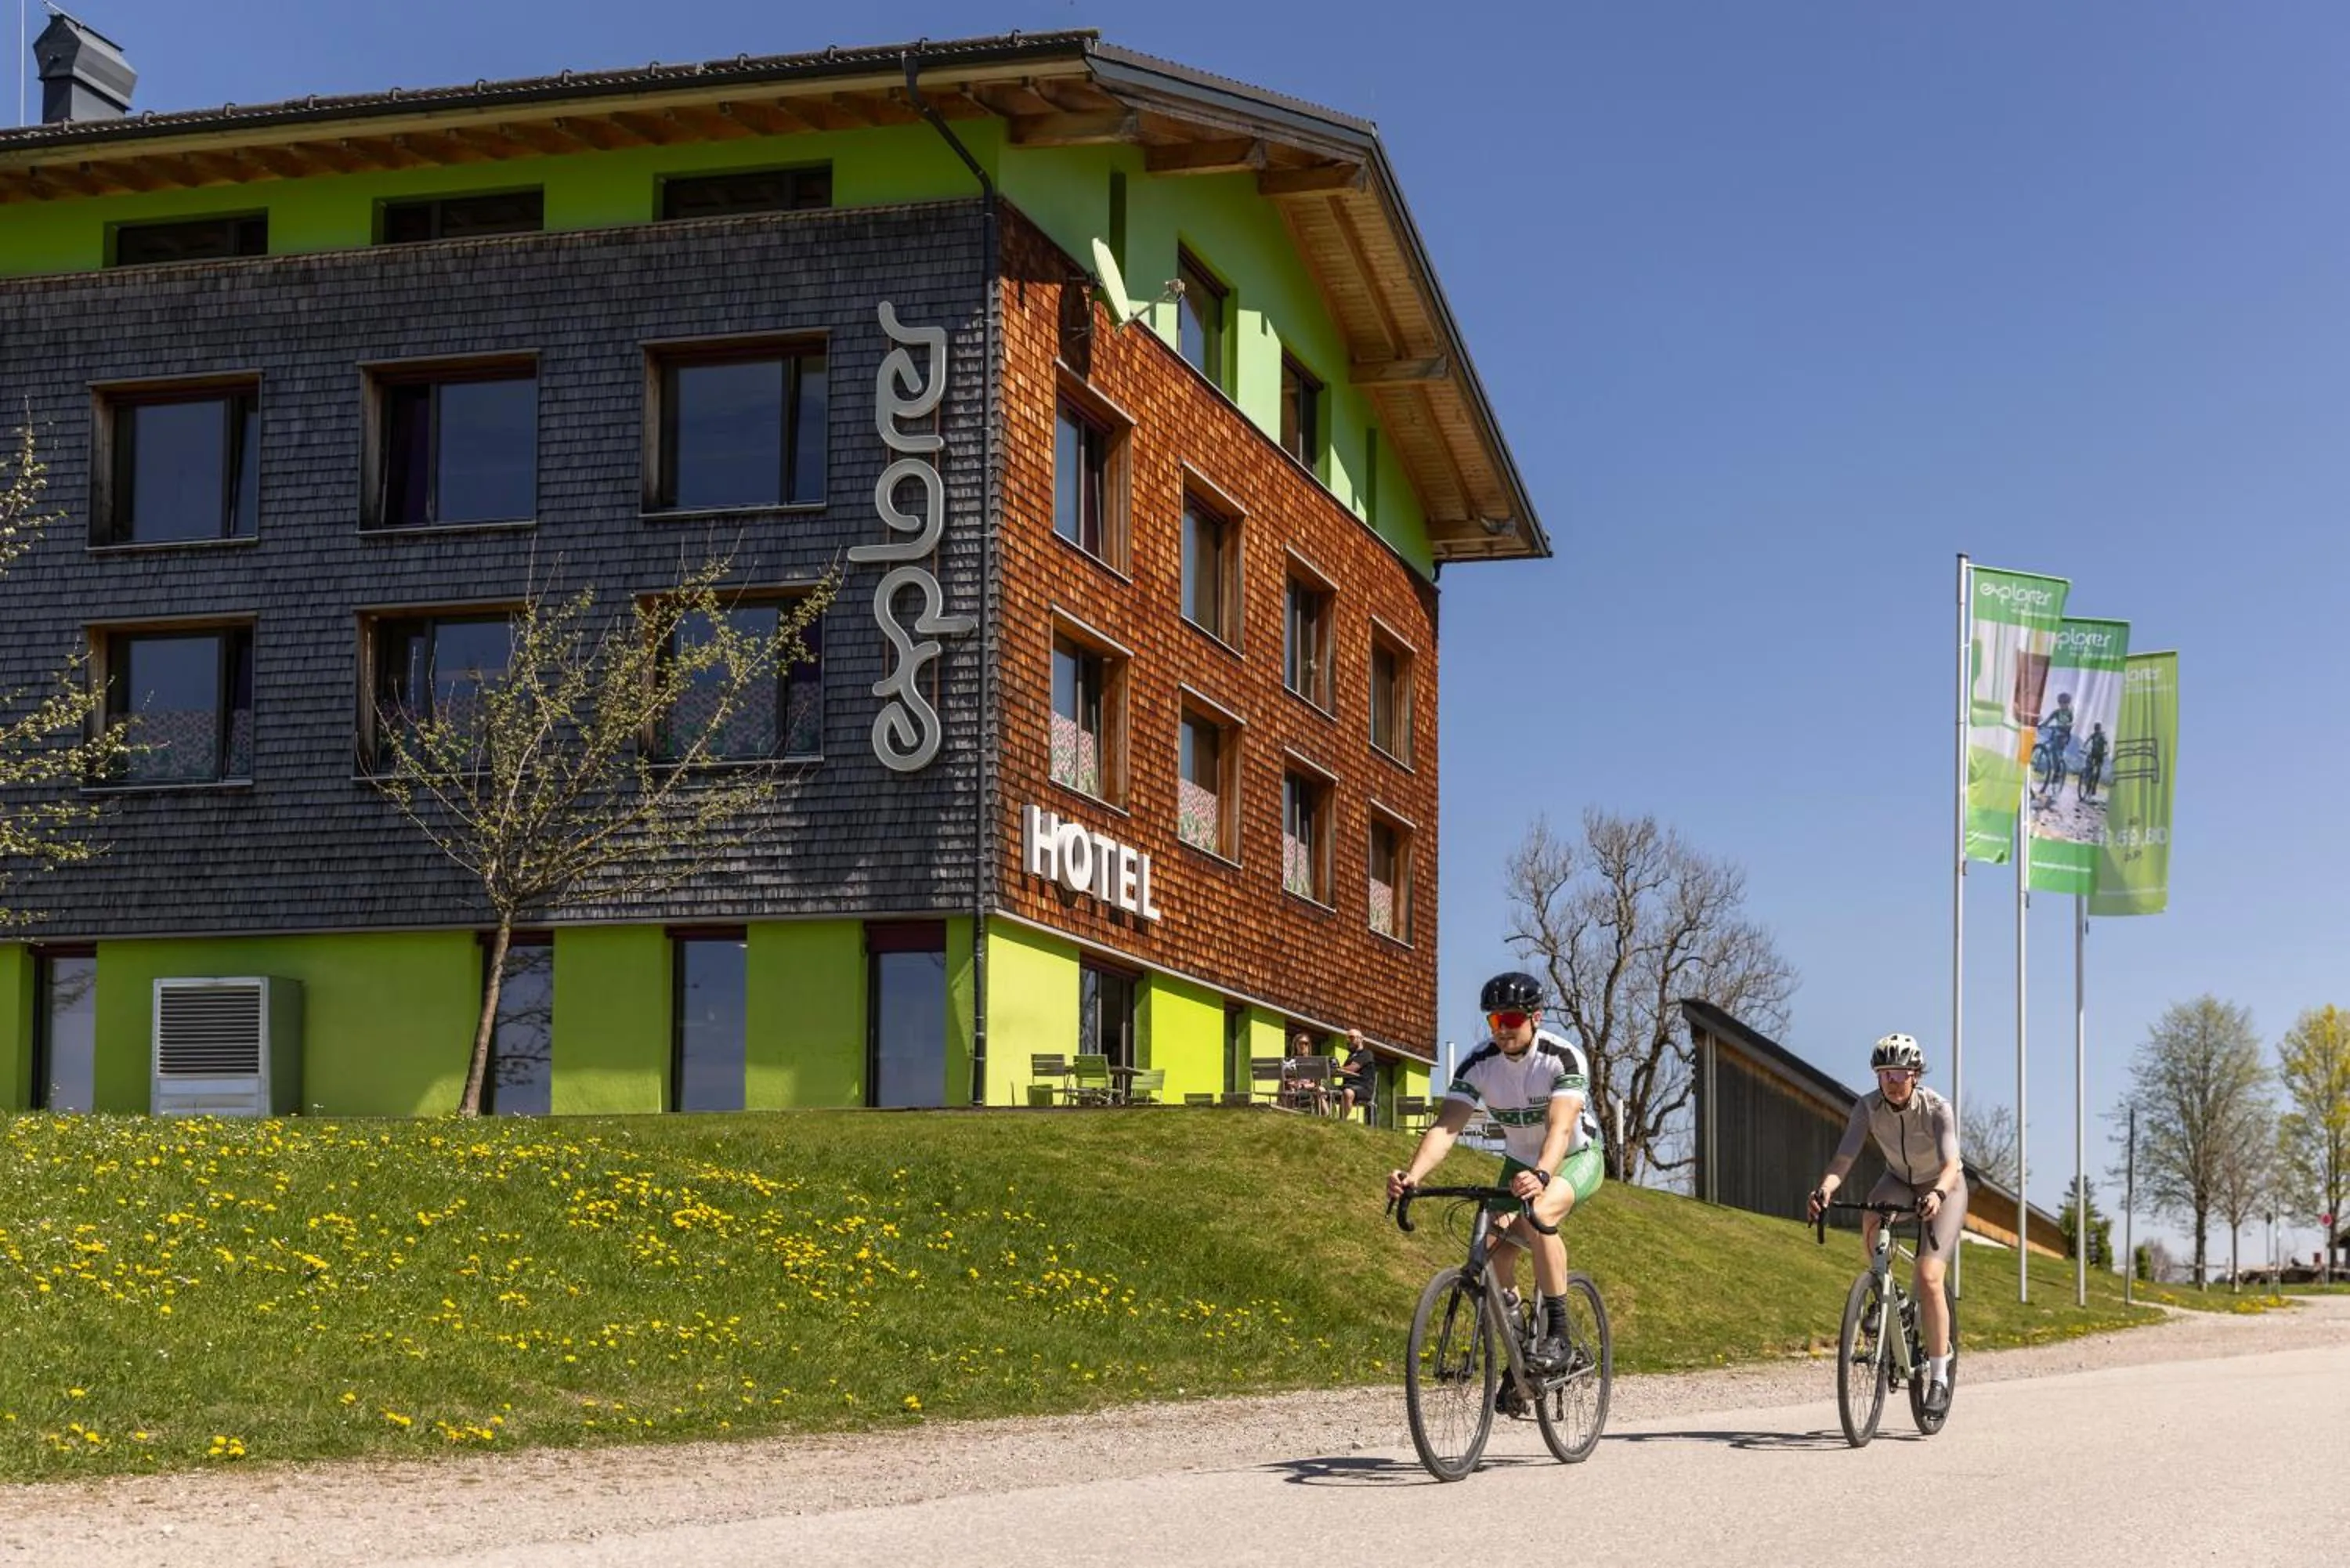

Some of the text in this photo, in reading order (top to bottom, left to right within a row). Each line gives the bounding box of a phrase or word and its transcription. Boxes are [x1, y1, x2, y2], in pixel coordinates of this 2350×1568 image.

[848, 301, 978, 772] explorer
[1979, 582, 2052, 606] explorer
[2057, 627, 2112, 651] plorer
[1022, 804, 1161, 921] HOTEL
